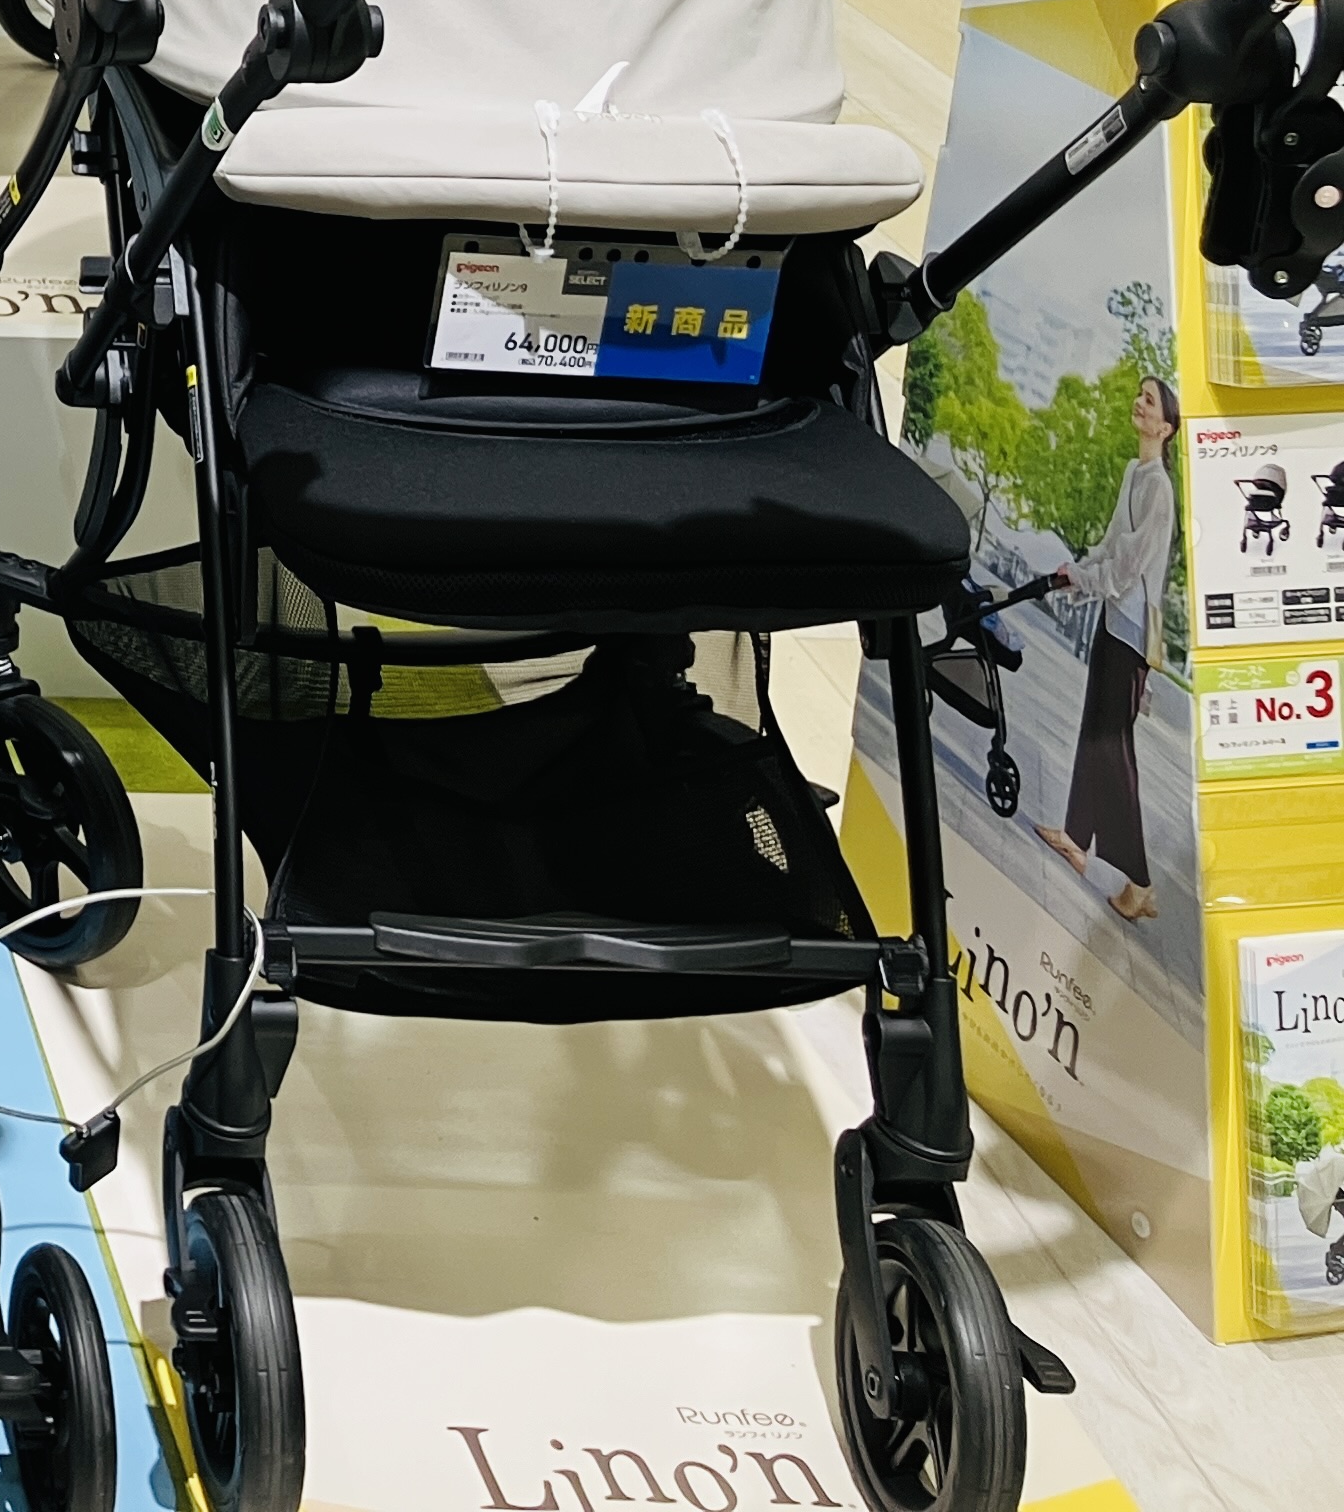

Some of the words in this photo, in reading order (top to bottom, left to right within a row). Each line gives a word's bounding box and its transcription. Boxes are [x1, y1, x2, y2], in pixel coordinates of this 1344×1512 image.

[455, 261, 500, 275] pigeon
[568, 274, 607, 287] SELECT
[623, 303, 751, 341] 新商品
[503, 331, 598, 356] 64,000円
[1196, 429, 1242, 444] pigeon
[1255, 669, 1335, 724] No.3
[1265, 952, 1305, 968] pigeon
